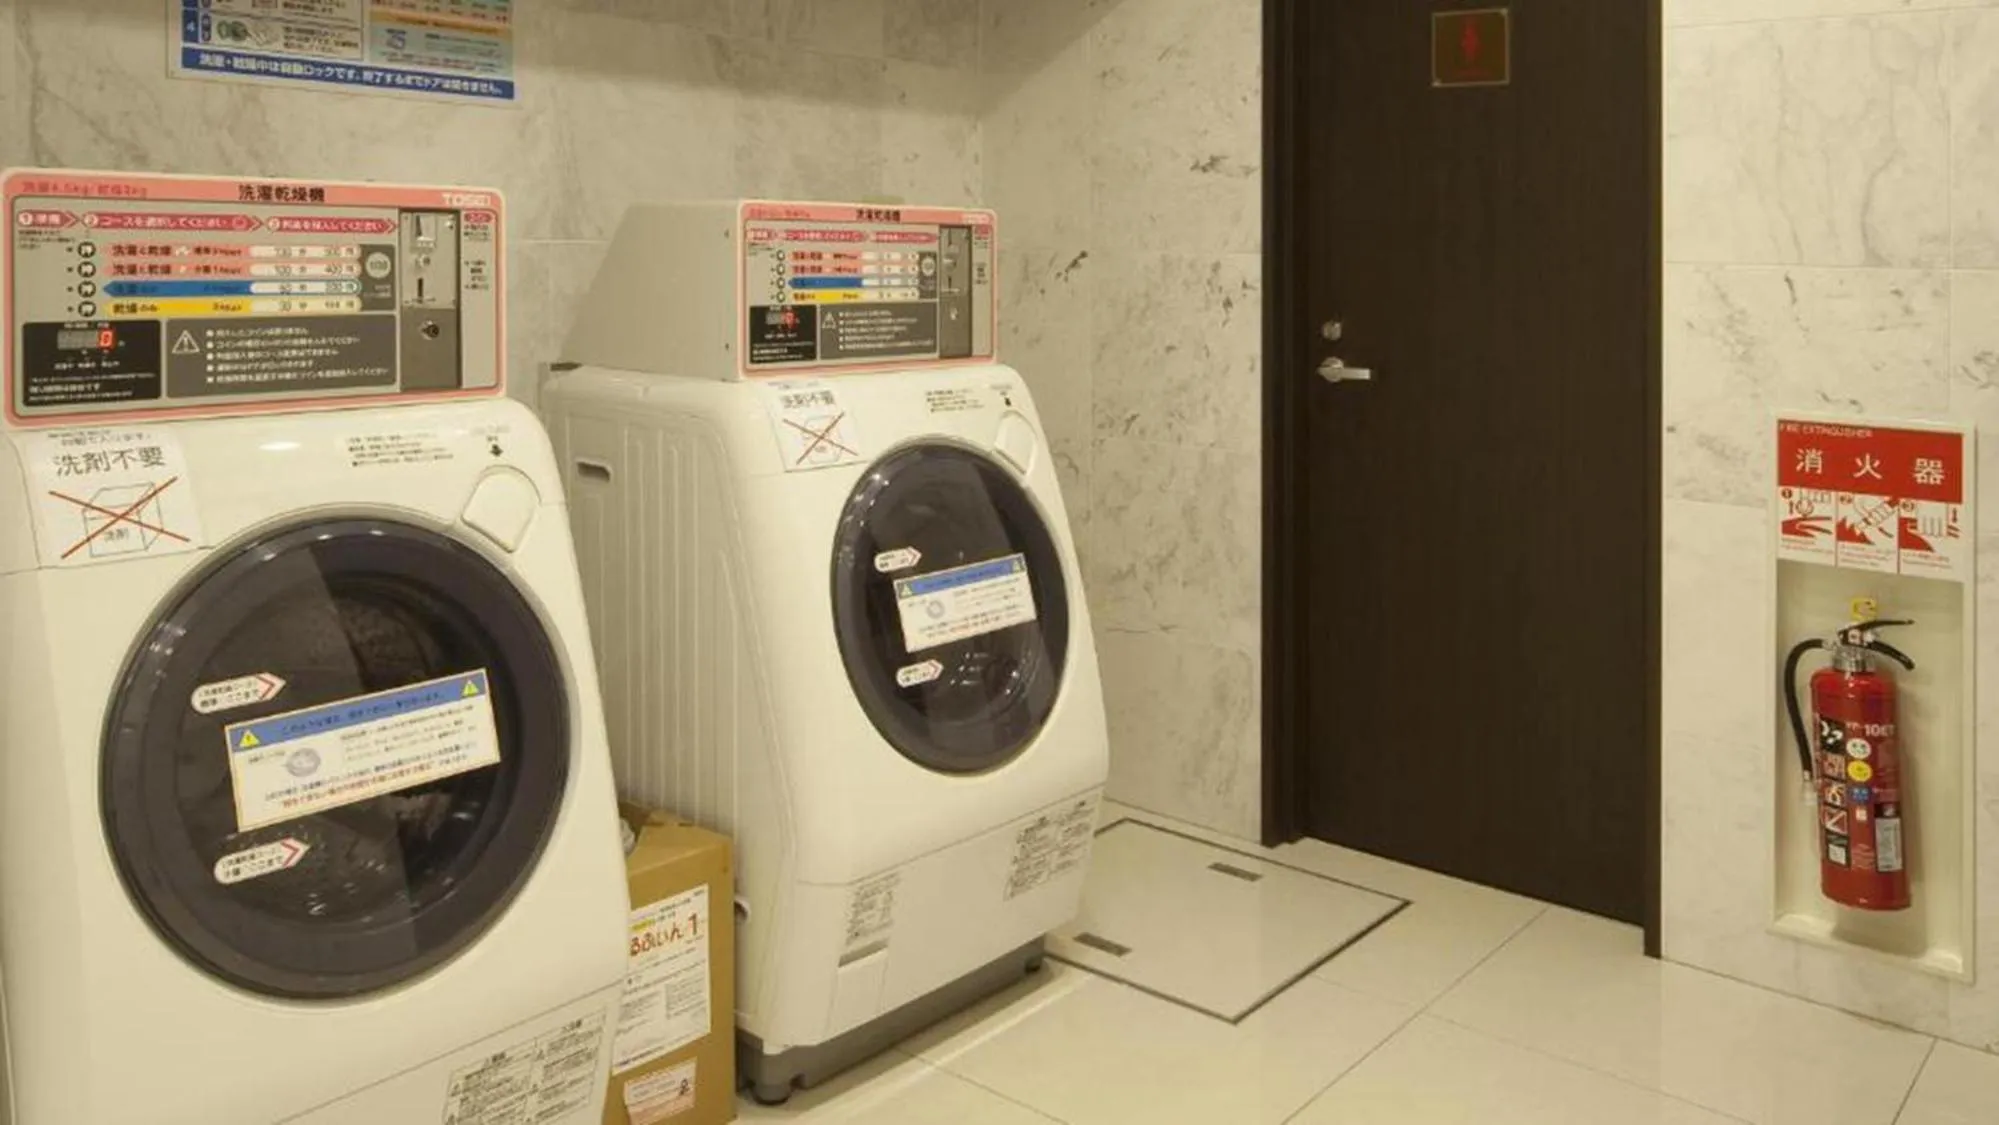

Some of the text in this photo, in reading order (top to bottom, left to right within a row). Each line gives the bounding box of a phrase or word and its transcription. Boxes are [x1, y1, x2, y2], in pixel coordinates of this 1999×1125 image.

[238, 184, 325, 203] 洗濯乾燥機
[52, 446, 168, 477] 洗剤不要
